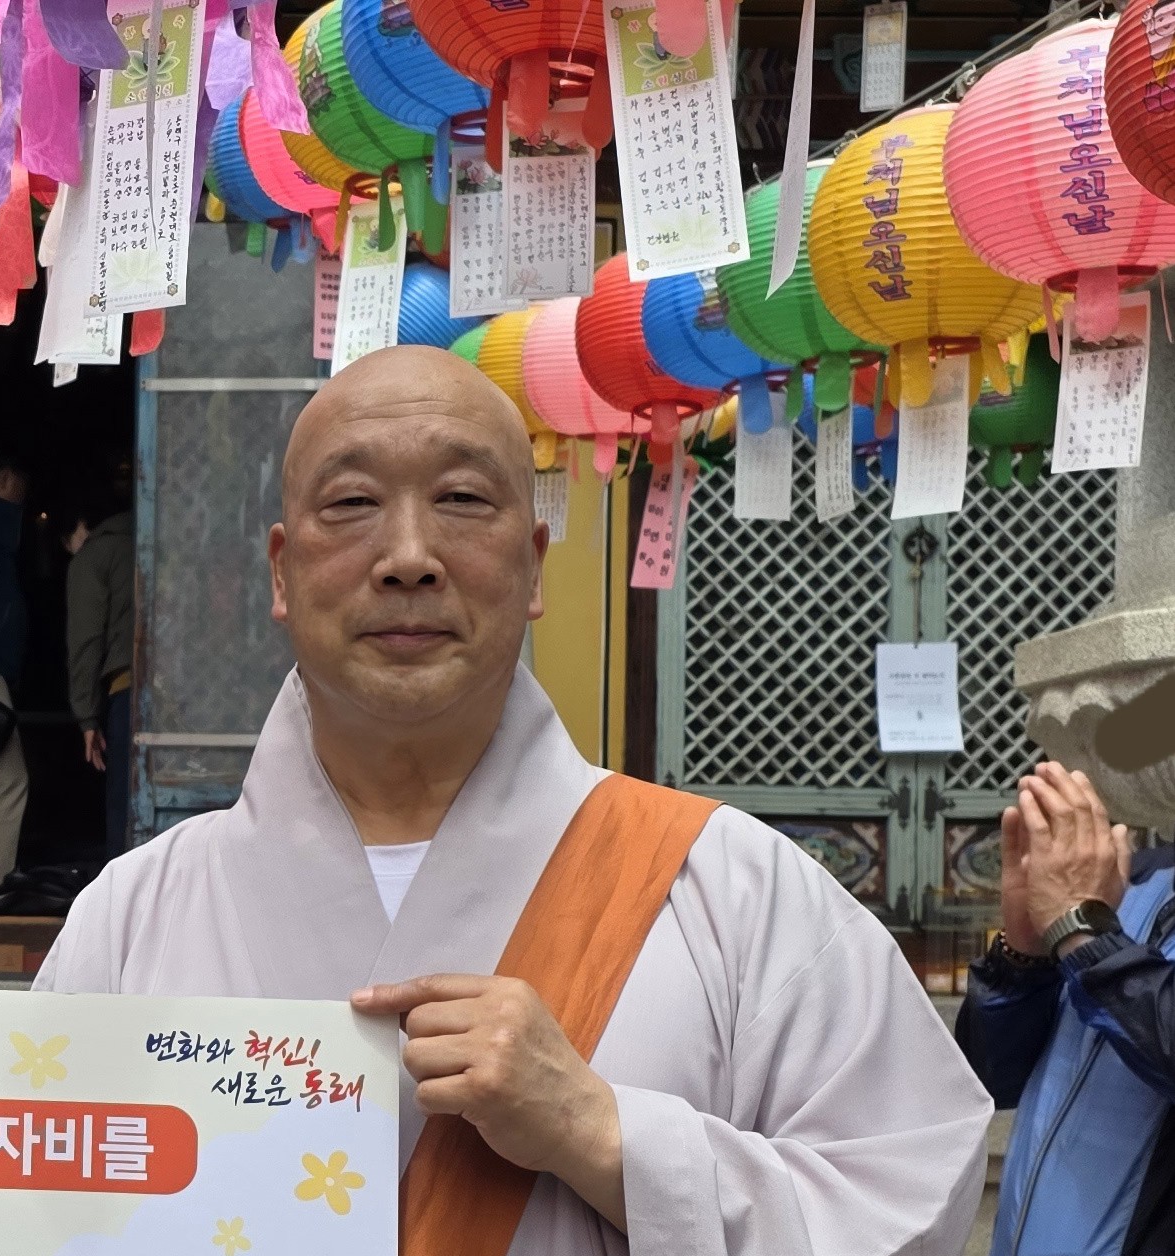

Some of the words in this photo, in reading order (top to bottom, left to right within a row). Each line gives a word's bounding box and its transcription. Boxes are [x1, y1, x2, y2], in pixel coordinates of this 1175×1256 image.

[146, 1031, 236, 1064] 변화와
[245, 1030, 322, 1071] 혁신!
[211, 1071, 292, 1107] 새로운
[300, 1069, 365, 1113] 동래
